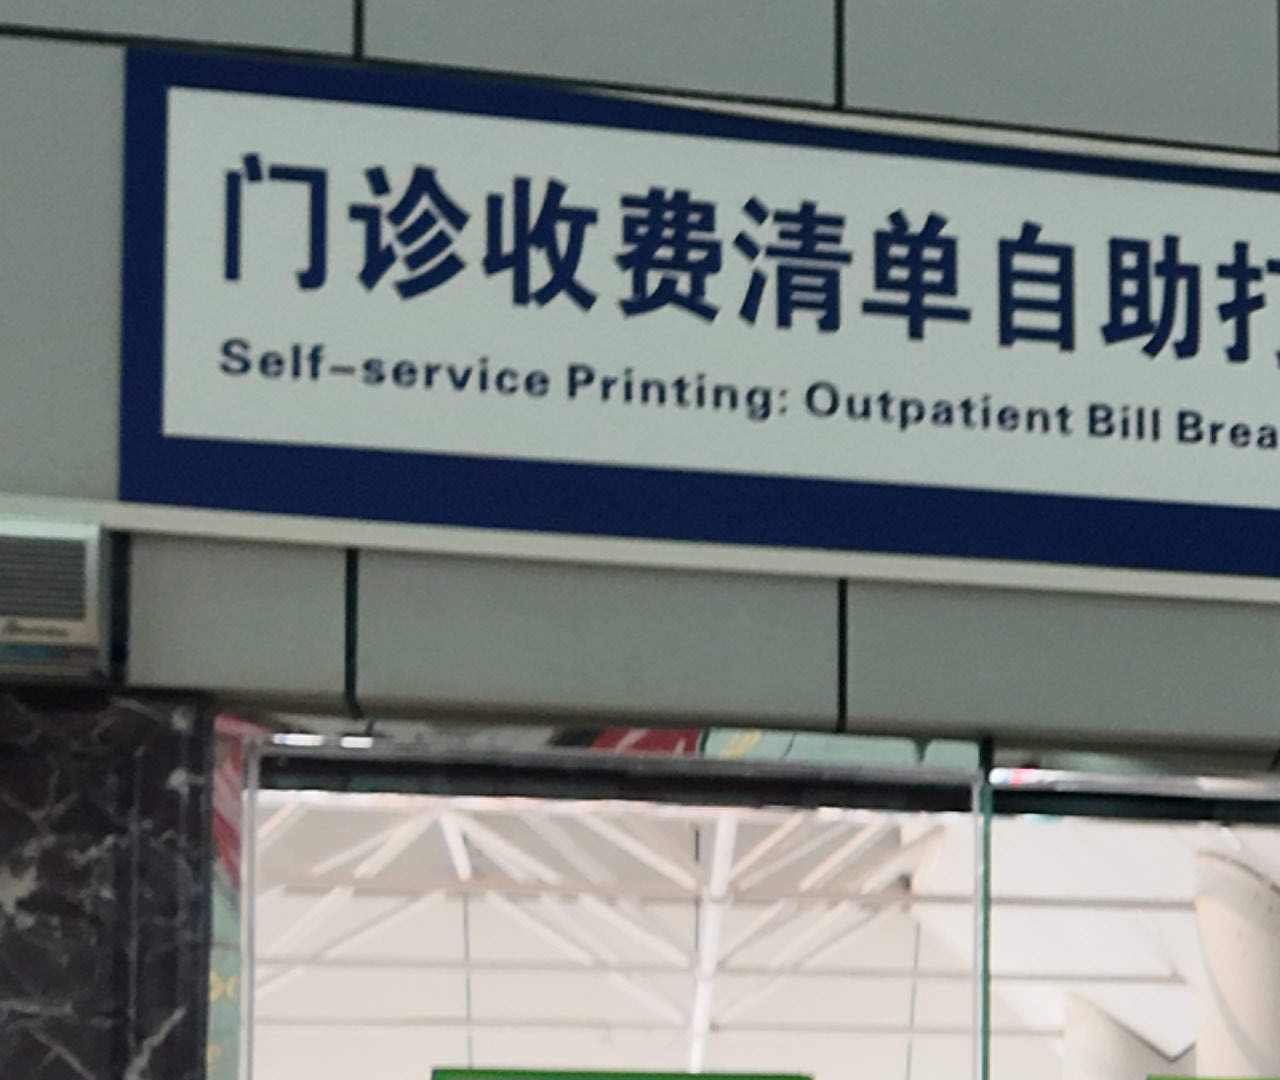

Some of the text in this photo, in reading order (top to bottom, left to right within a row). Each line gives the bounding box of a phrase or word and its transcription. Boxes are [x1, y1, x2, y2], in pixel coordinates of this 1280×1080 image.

[220, 338, 550, 397] Self-service
[568, 364, 787, 421] Printing:
[805, 382, 1072, 434] Outpatient
[1089, 404, 1161, 441] Bill
